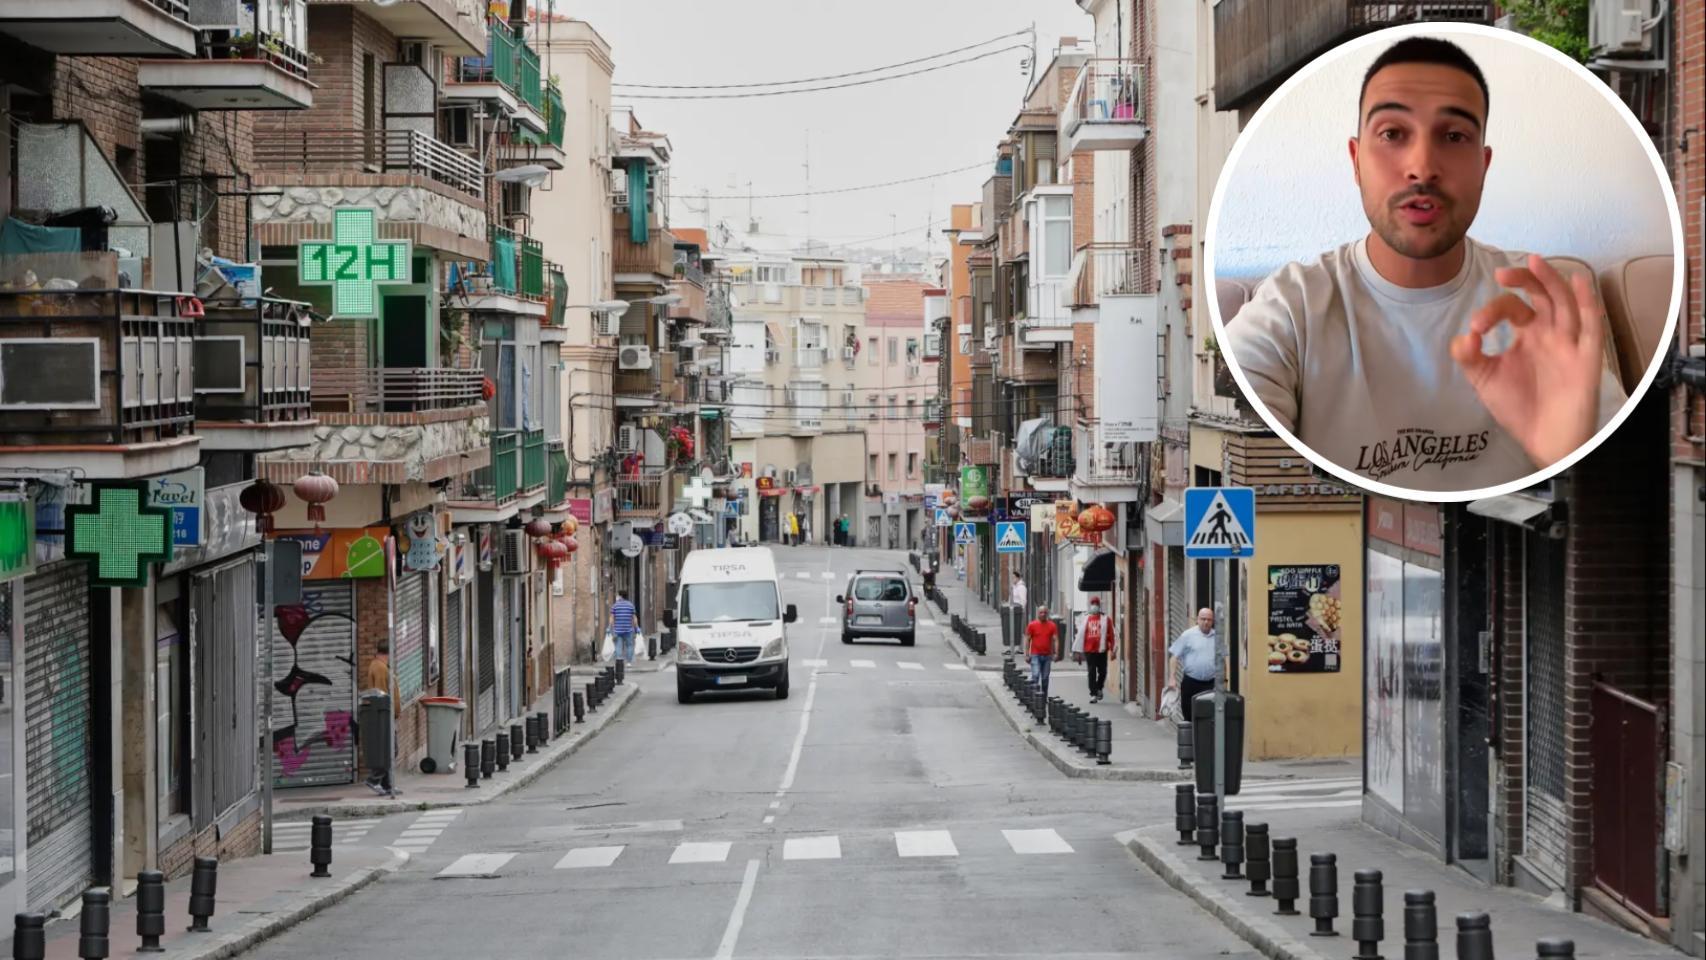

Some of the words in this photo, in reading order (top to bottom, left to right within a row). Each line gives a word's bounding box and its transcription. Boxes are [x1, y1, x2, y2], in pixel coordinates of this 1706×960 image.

[312, 244, 395, 280] 12H
[1355, 440, 1389, 470] LOS
[1391, 430, 1489, 461] ANGELES
[1413, 448, 1480, 471] California
[173, 529, 188, 539] 16
[708, 631, 752, 639] TIPSA
